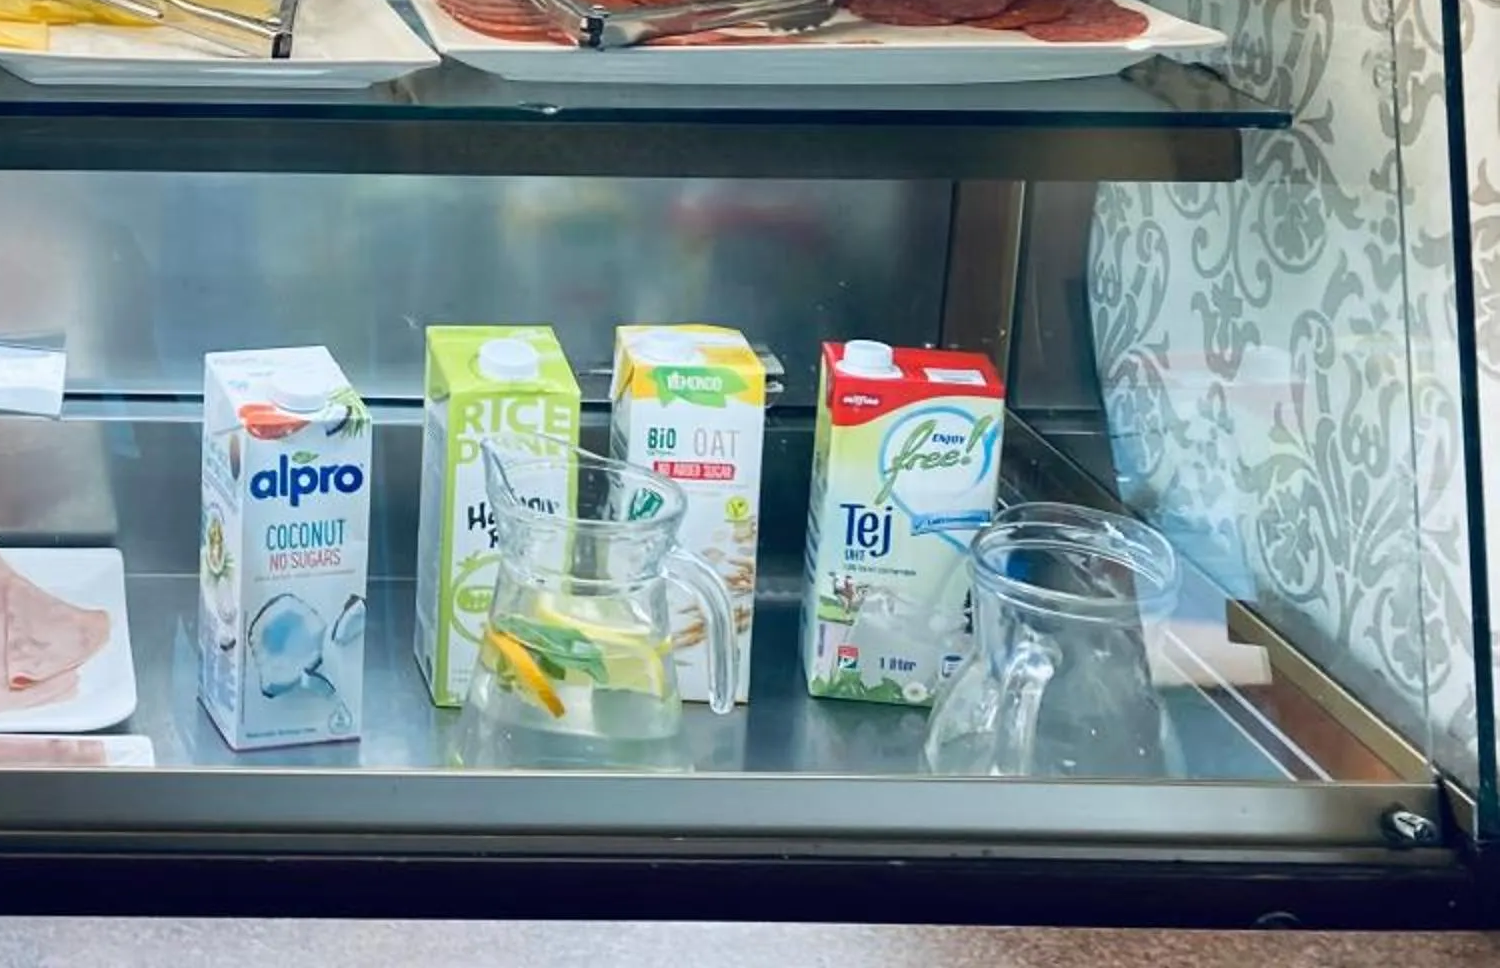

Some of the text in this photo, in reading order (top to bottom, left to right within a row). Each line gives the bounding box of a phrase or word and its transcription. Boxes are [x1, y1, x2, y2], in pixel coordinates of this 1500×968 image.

[458, 397, 571, 434] RICE
[693, 427, 742, 457] OAT
[874, 415, 994, 505] free!
[250, 453, 363, 507] alpro
[266, 518, 346, 550] COCONUT
[839, 503, 893, 557] Tej
[269, 548, 342, 572] NO SUGARS
